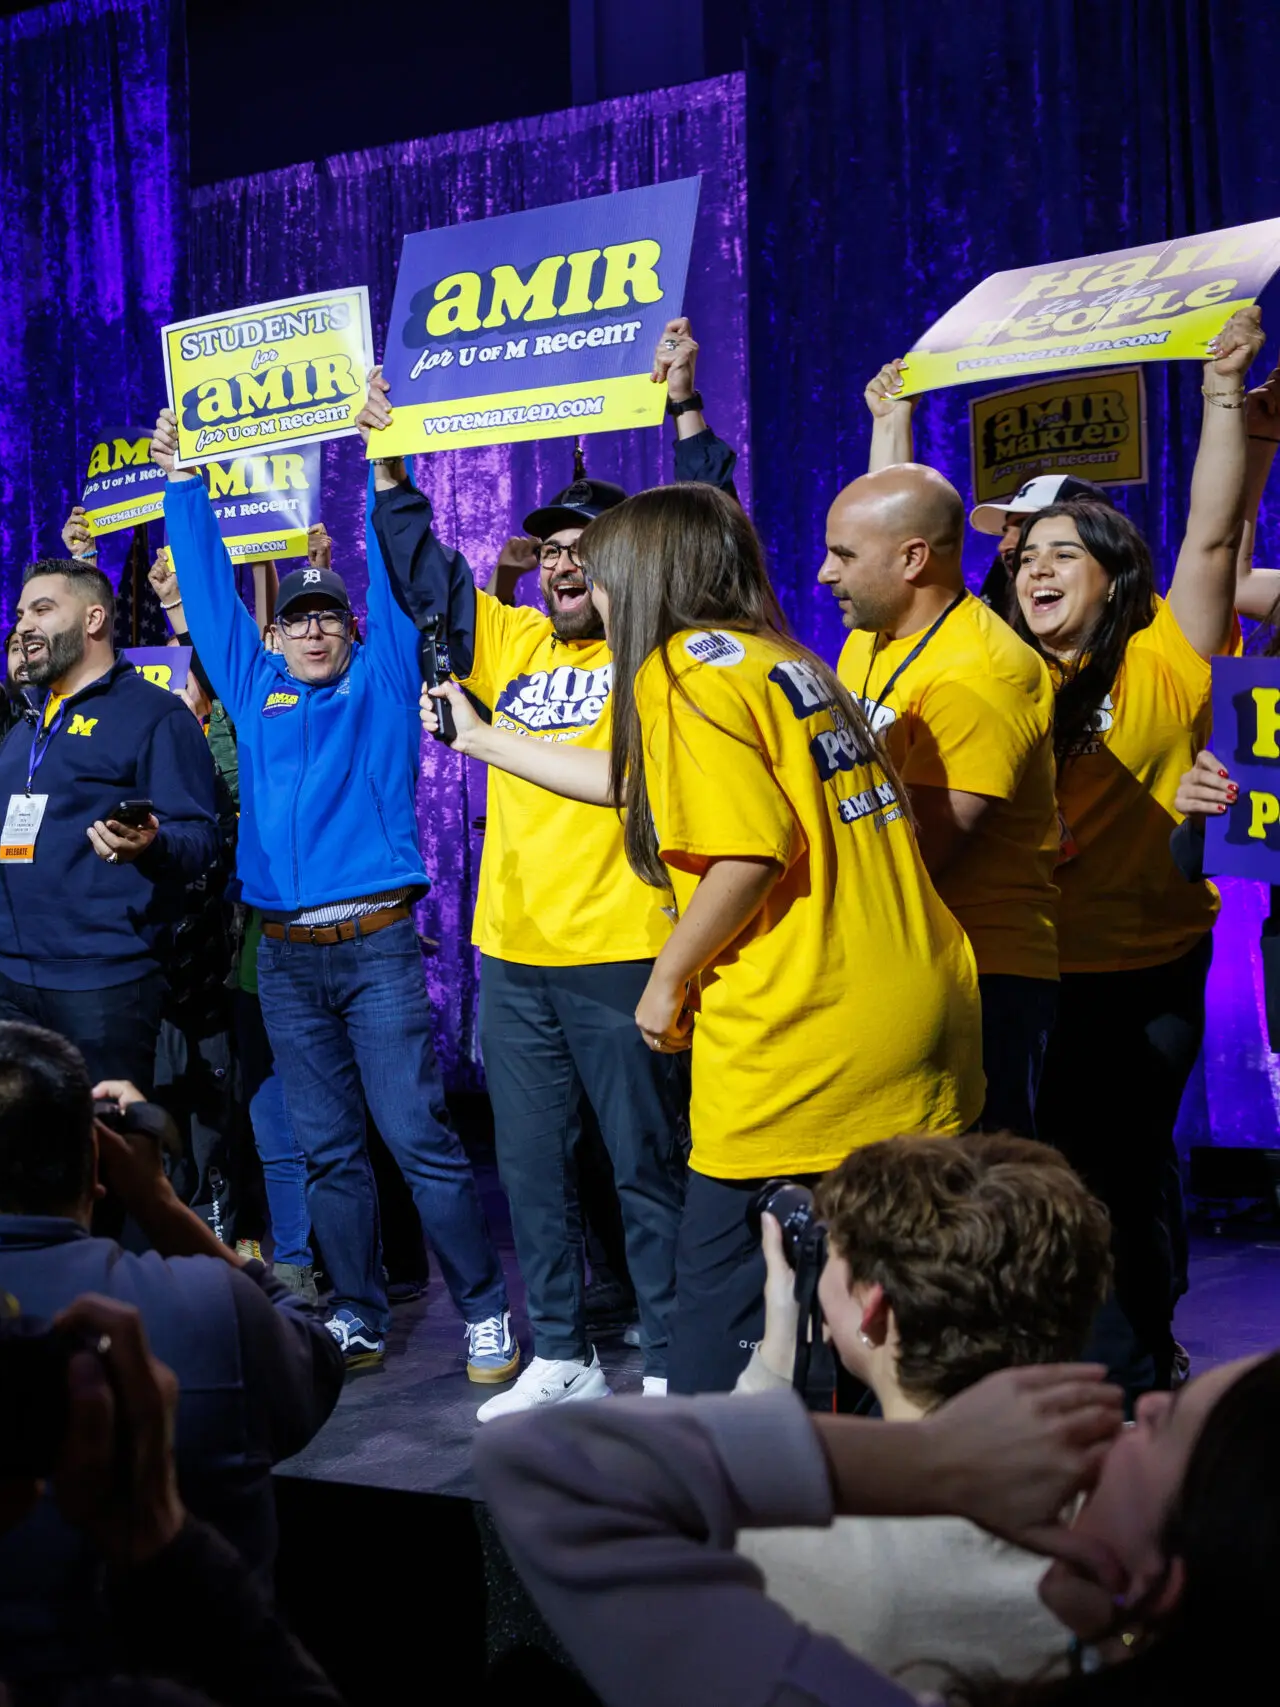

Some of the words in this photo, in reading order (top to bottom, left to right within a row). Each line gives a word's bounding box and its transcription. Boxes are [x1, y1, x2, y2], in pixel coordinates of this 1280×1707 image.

[181, 303, 350, 360] STUDENTS
[251, 349, 278, 370] for
[409, 348, 455, 380] for
[458, 345, 478, 367] U
[504, 337, 529, 360] M
[196, 429, 225, 452] for
[227, 427, 241, 440] U
[260, 419, 276, 435] M
[81, 482, 100, 502] for
[101, 479, 111, 491] U
[124, 473, 136, 485] M
[196, 453, 310, 500] MIR
[224, 505, 237, 519] M
[67, 713, 99, 737] M
